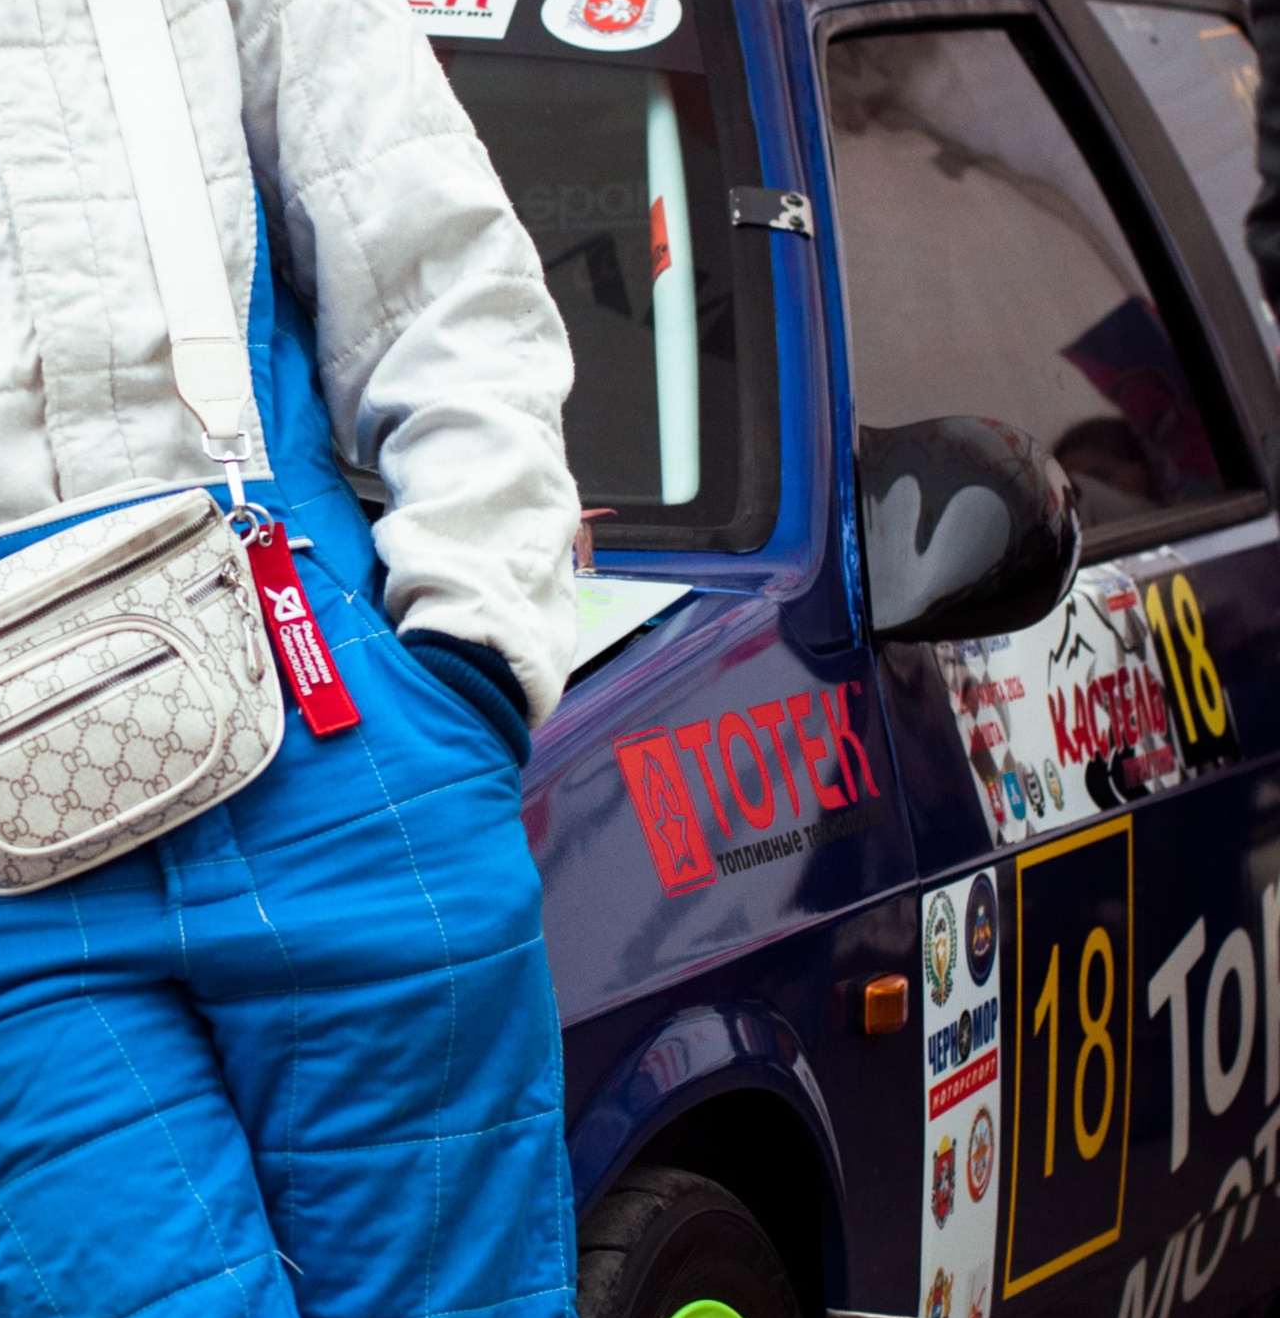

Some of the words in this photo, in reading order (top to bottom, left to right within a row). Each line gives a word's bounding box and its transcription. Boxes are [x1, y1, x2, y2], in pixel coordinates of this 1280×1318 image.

[1145, 572, 1228, 745] 18
[674, 682, 881, 840] ТОТЕК
[716, 828, 804, 877] топливные
[1033, 925, 1115, 1179] 18
